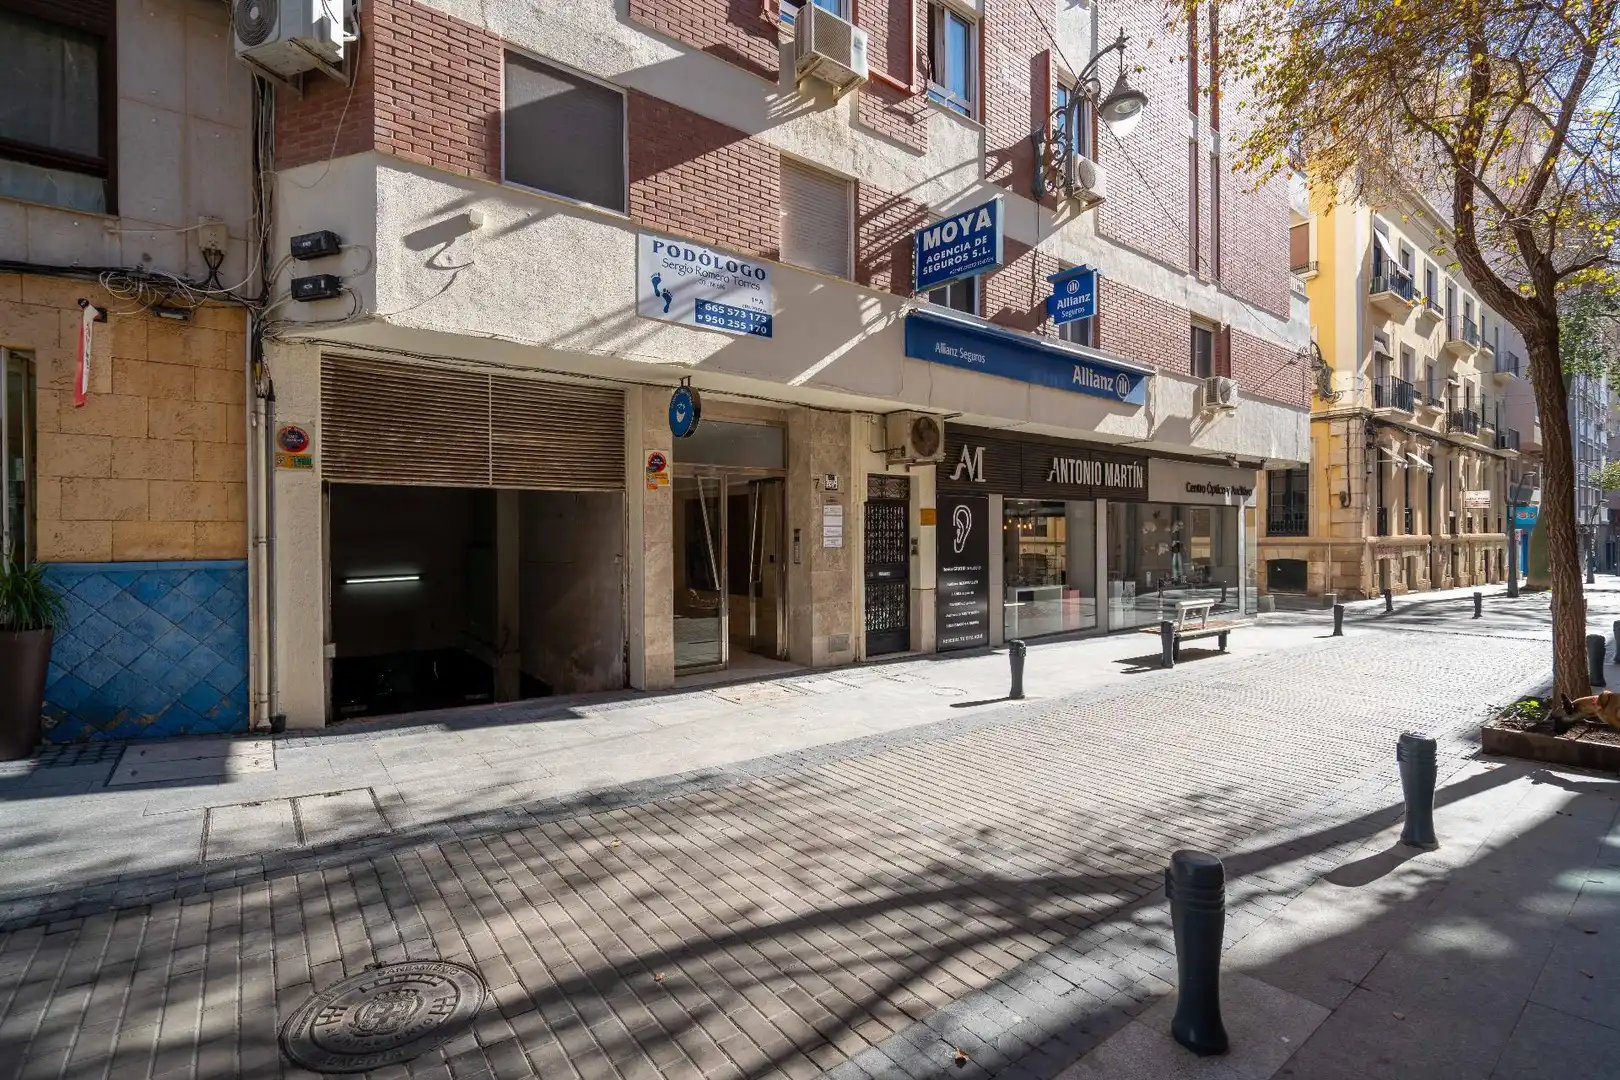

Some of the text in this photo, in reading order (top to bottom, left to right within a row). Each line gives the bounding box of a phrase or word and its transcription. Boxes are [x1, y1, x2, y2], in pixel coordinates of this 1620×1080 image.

[923, 208, 992, 251] MOYA
[652, 240, 766, 281] PODÓLOGO
[922, 252, 969, 275] SEGUROS
[972, 246, 991, 259] S.L.
[926, 235, 987, 264] AGENCIA DE
[661, 257, 694, 276] Sergio
[695, 265, 730, 283] Romero
[731, 274, 761, 291] Torres
[705, 303, 725, 314] 665
[727, 308, 747, 319] 573
[748, 312, 767, 323] 173
[1057, 293, 1091, 310] Allianz
[1061, 307, 1085, 318] Seguros
[704, 315, 767, 334] 950 255 170
[934, 342, 986, 365] Allianz Seguros
[1072, 365, 1114, 392] Allianz
[813, 478, 820, 489] 7
[1046, 457, 1143, 488] ANTONIO MARTÍN
[1185, 481, 1206, 494] Centro
[1207, 481, 1226, 496] Óptico
